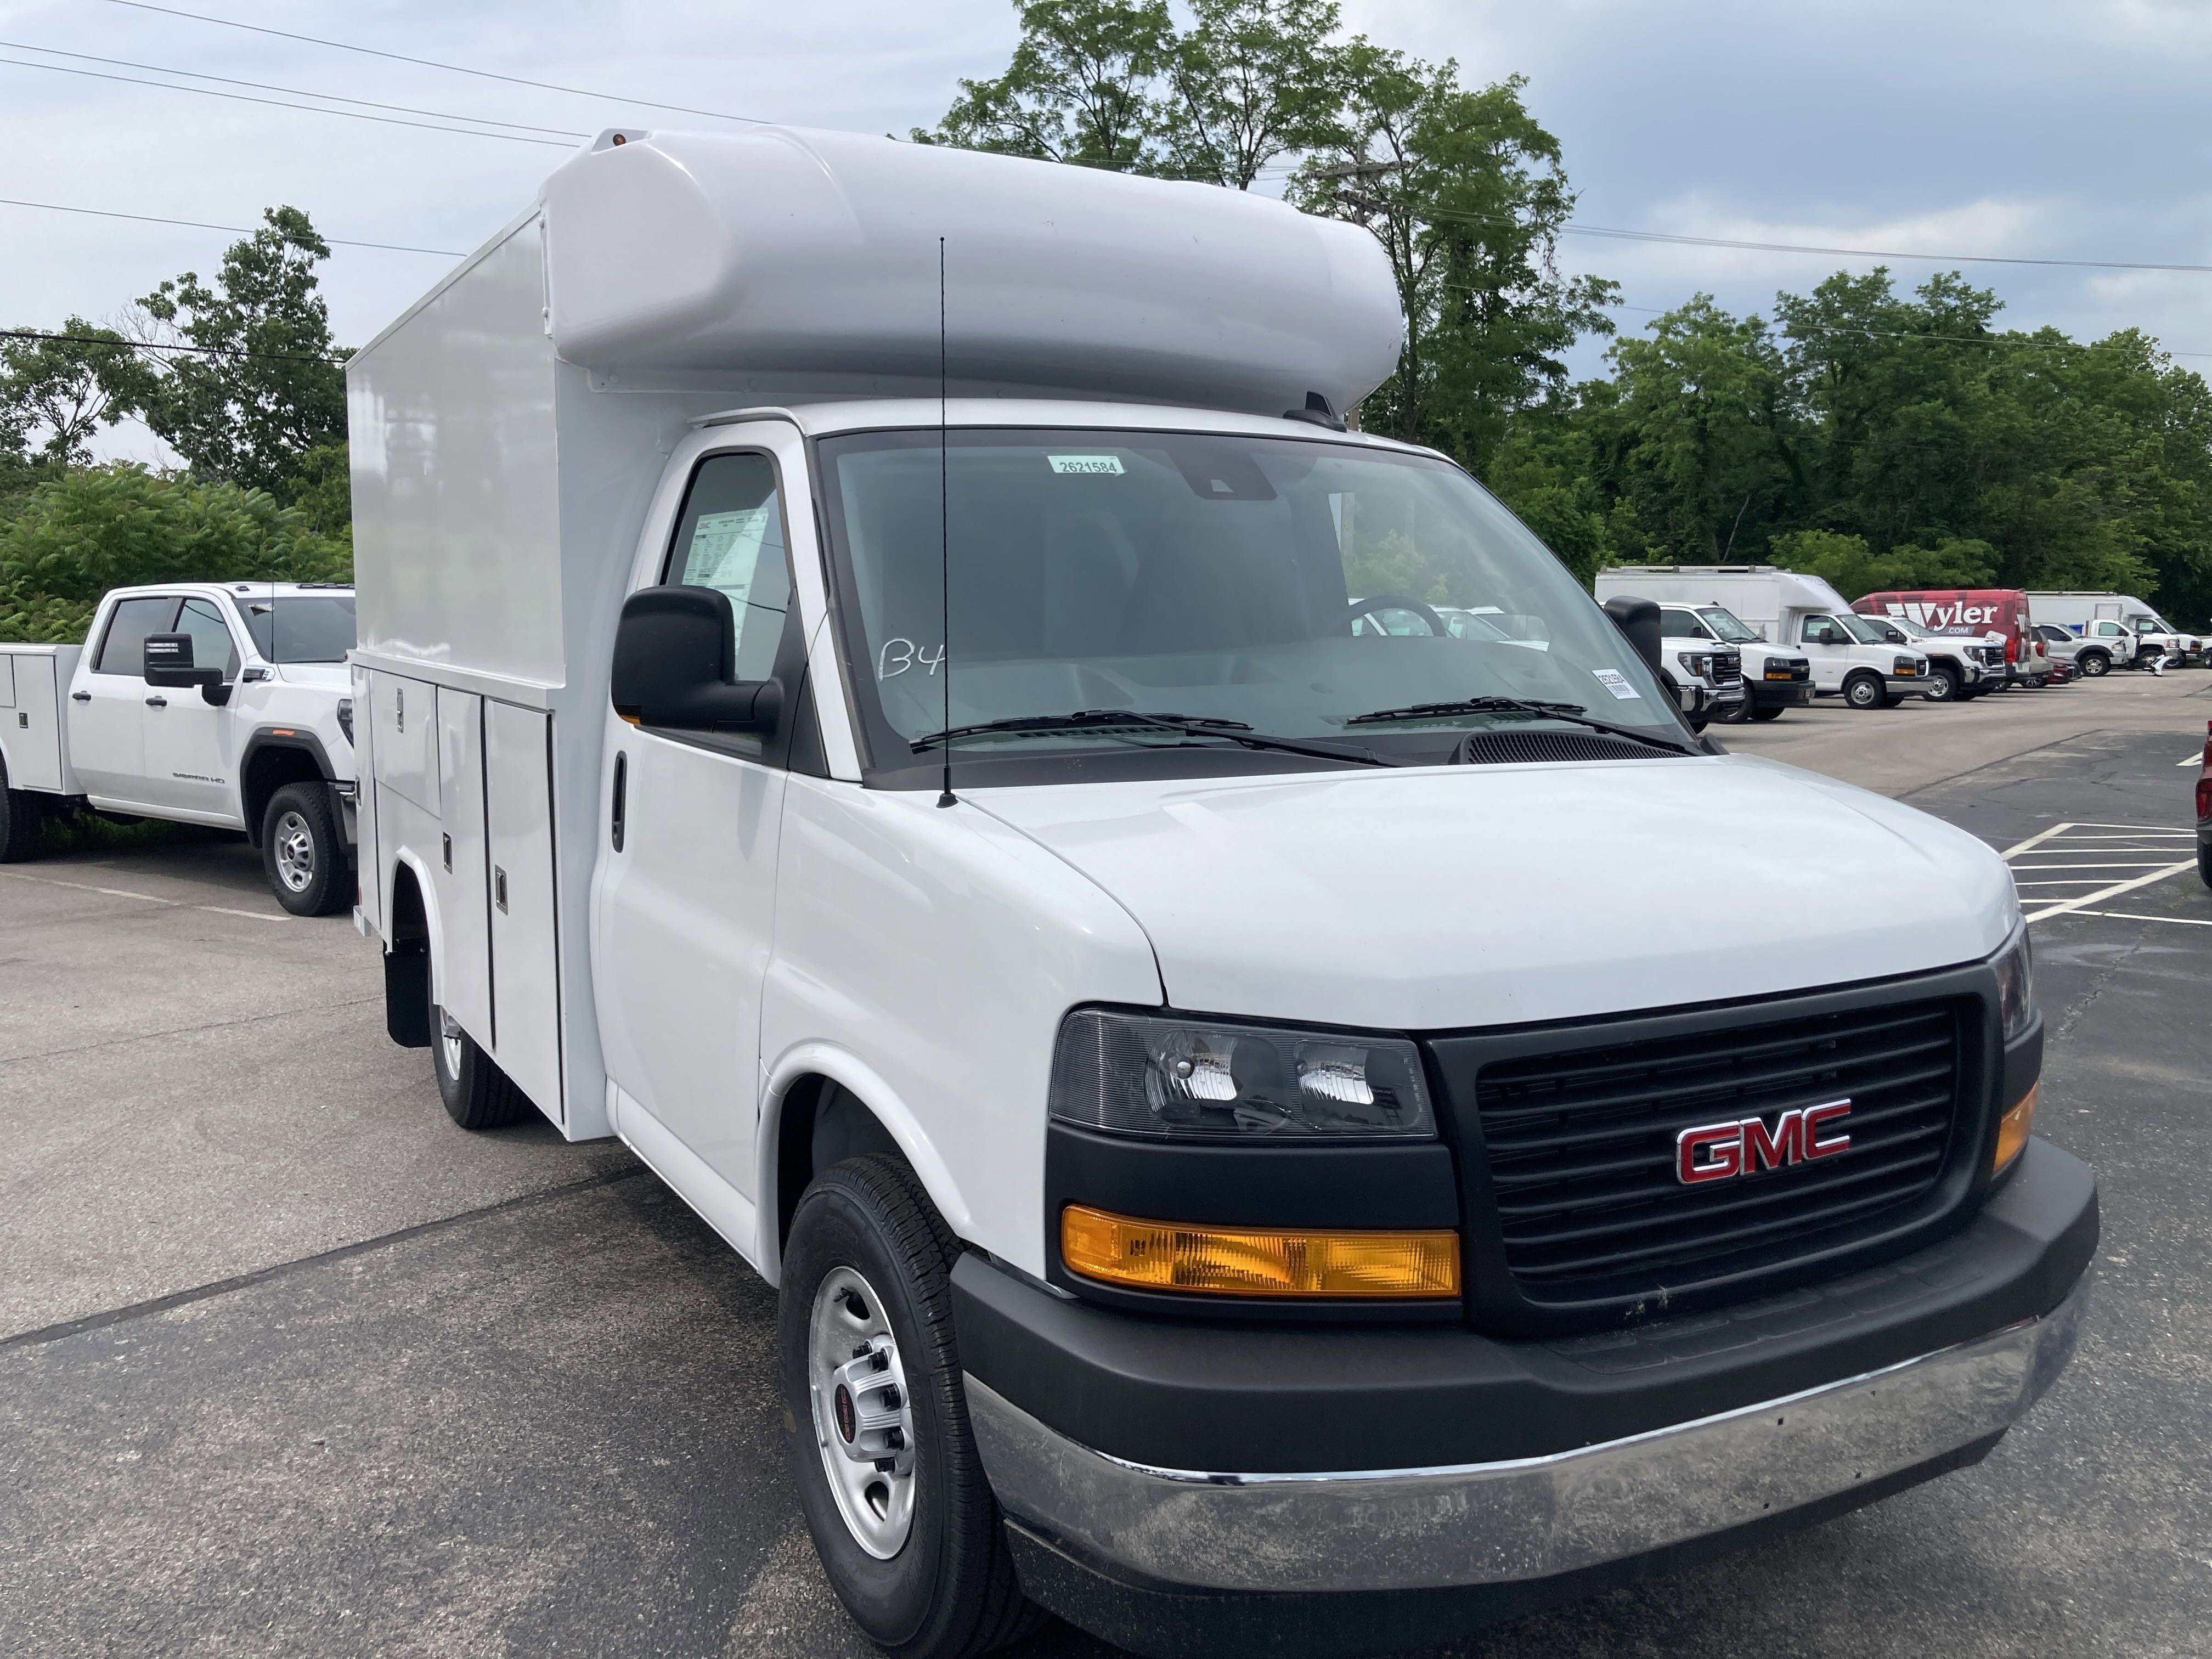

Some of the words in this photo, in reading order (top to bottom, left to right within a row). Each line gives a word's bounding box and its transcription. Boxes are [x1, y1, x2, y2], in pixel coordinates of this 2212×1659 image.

[1059, 462, 1118, 473] 2621584
[1886, 601, 1998, 631] Wyler
[878, 638, 947, 682] B4
[1676, 1098, 1852, 1184] GMC
[840, 1387, 851, 1441] GMC
